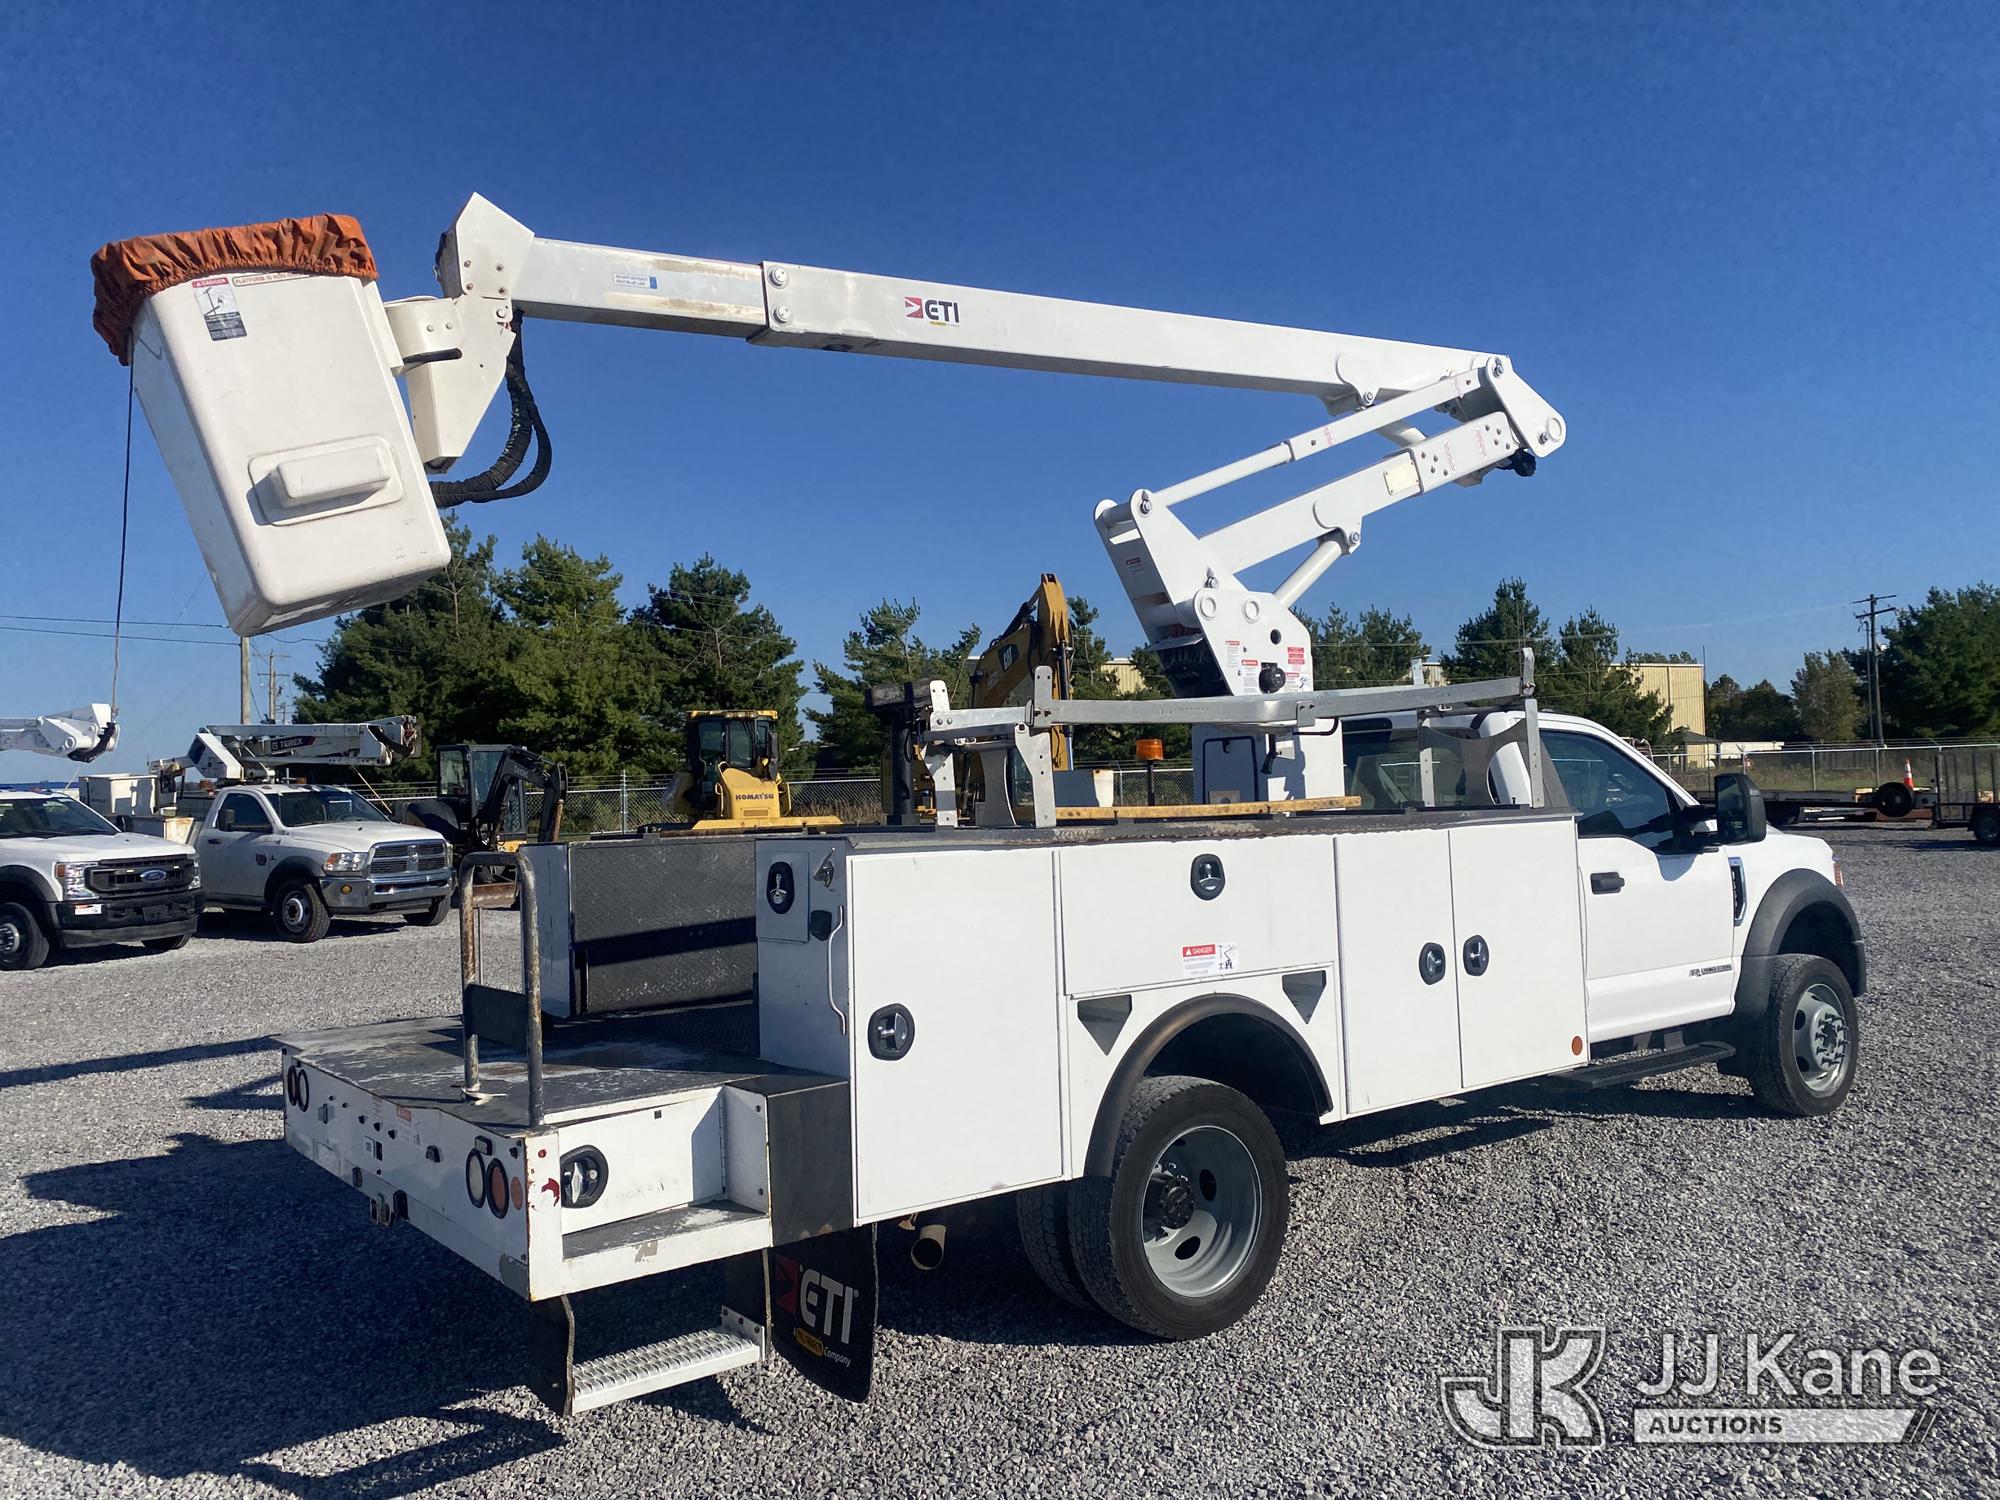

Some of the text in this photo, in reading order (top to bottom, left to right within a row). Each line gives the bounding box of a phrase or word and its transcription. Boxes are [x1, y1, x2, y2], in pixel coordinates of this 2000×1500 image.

[924, 299, 960, 323] ETI
[280, 737, 303, 748] TEREX
[735, 792, 774, 801] KOMATSU
[1192, 946, 1213, 955] DANGER
[800, 1268, 853, 1345] ETI
[823, 1346, 852, 1368] Company
